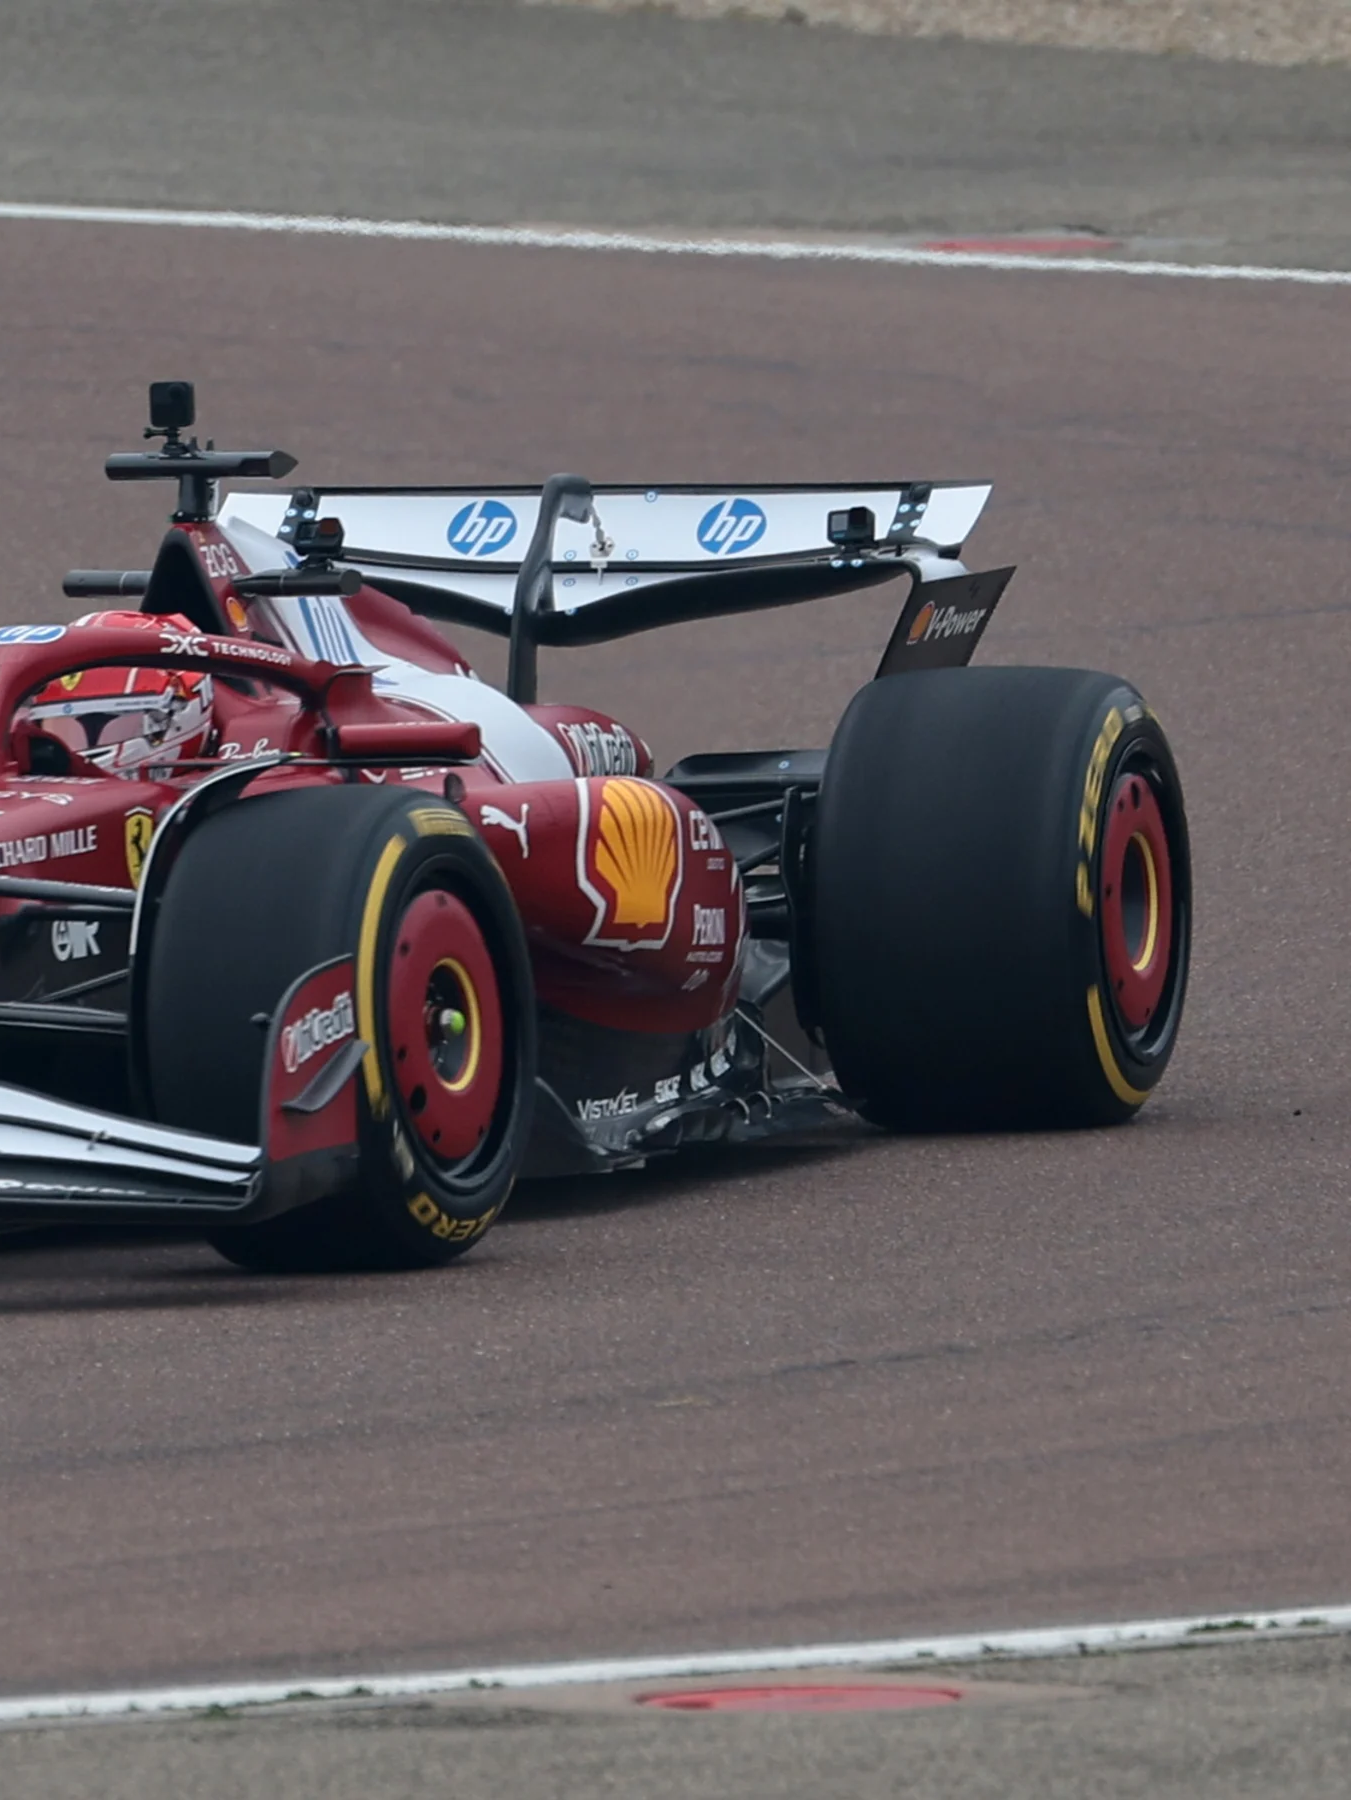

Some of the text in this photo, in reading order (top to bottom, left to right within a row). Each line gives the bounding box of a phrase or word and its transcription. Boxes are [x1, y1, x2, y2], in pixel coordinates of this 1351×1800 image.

[450, 500, 514, 556] hp
[700, 498, 764, 555] hp
[923, 606, 986, 641] V-Power
[211, 642, 291, 665] TECHNOLOGY
[50, 825, 98, 859] MILLE
